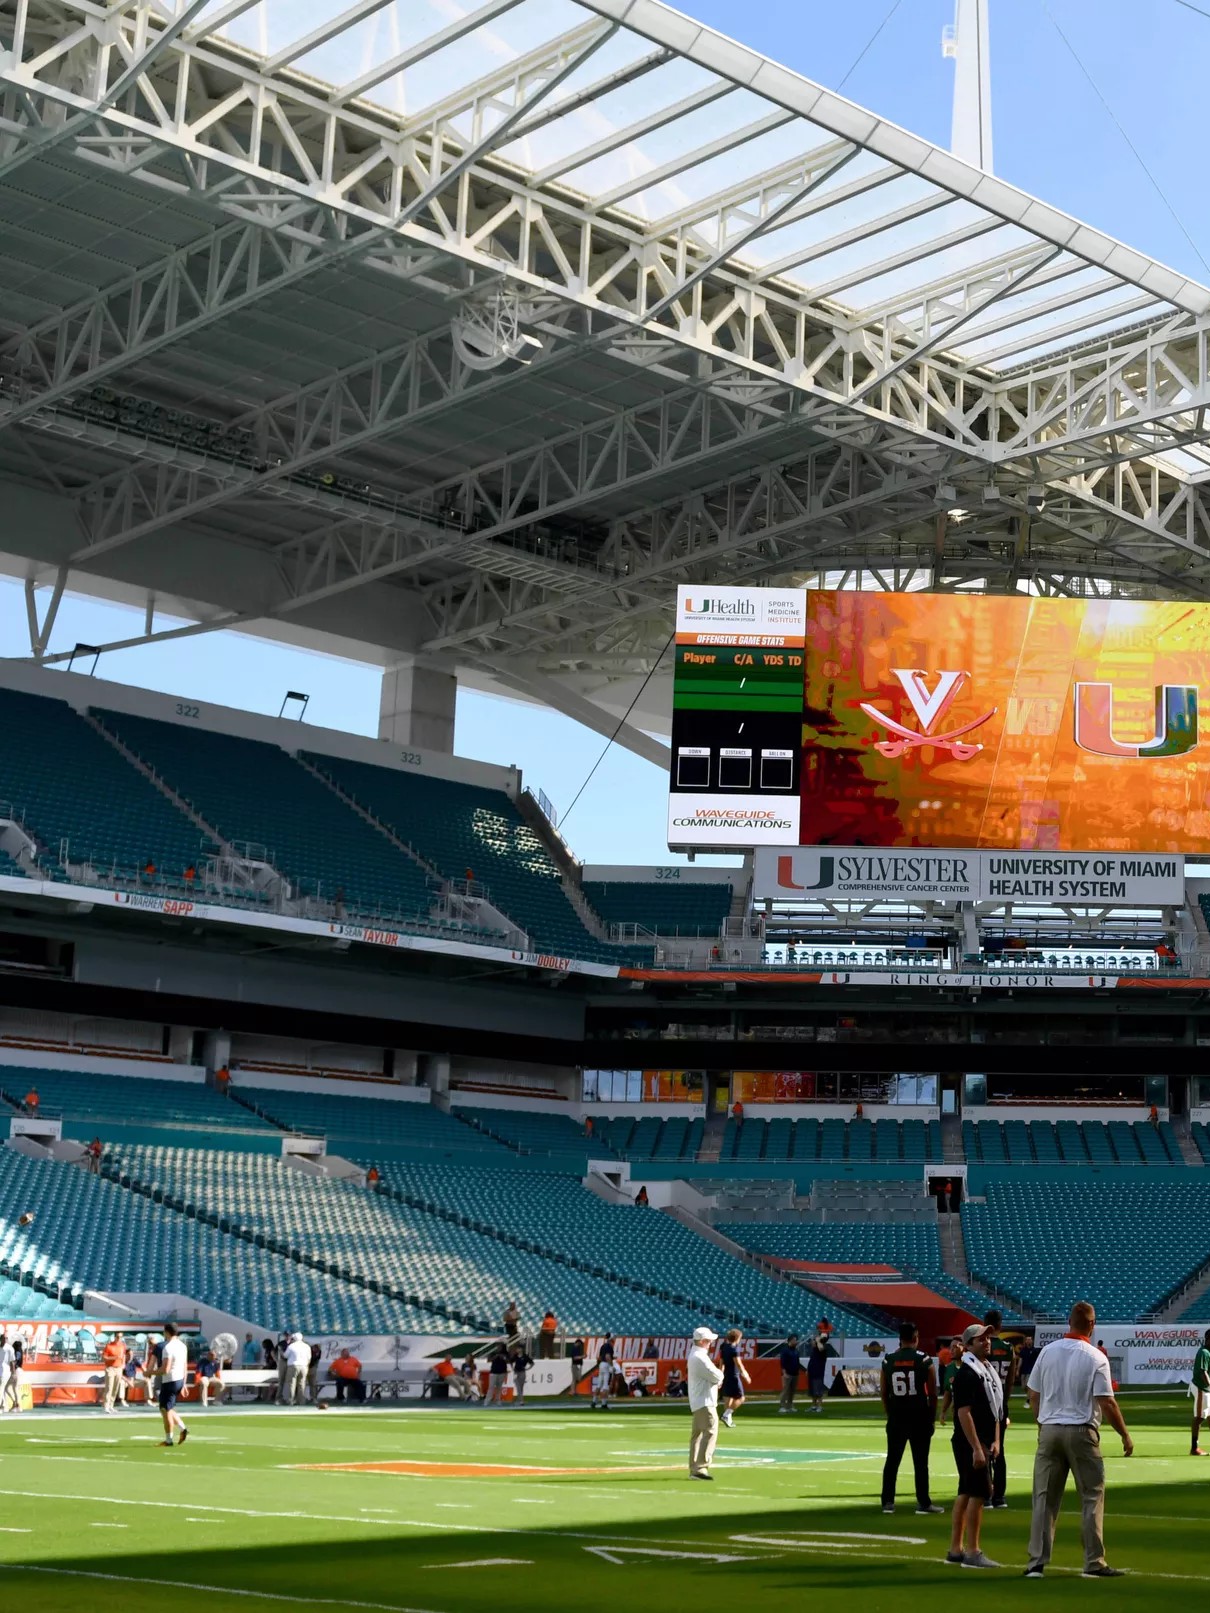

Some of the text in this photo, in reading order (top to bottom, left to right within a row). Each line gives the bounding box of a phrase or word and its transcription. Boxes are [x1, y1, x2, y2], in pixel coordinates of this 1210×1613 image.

[696, 635, 785, 646] OFFENSIVE GAME STATS
[683, 652, 802, 666] Player C/A YDS TD
[176, 703, 200, 719] 322
[401, 752, 422, 765] 323
[695, 809, 775, 819] WAVEGUIDE
[673, 818, 792, 828] COMMUNICATIONS
[655, 868, 681, 879] 324
[838, 856, 969, 883] SYLVESTER
[989, 858, 1176, 878] UNIVERSITY OF MIAMI
[838, 883, 970, 893] COMPREHENSIVE CANCER CENTER
[989, 880, 1126, 898] HEALTH SYSTEM
[130, 895, 163, 909] WARREN
[163, 900, 194, 915] SAPP
[344, 926, 362, 937] SEAN
[363, 928, 399, 945] TAYLOR
[537, 954, 571, 970] DOOLEY
[891, 974, 1055, 987] RING of HONOR
[1135, 1330, 1198, 1339] WAVEGUIDE
[1114, 1339, 1205, 1347] COMMUNICATION
[891, 1371, 917, 1397] 61
